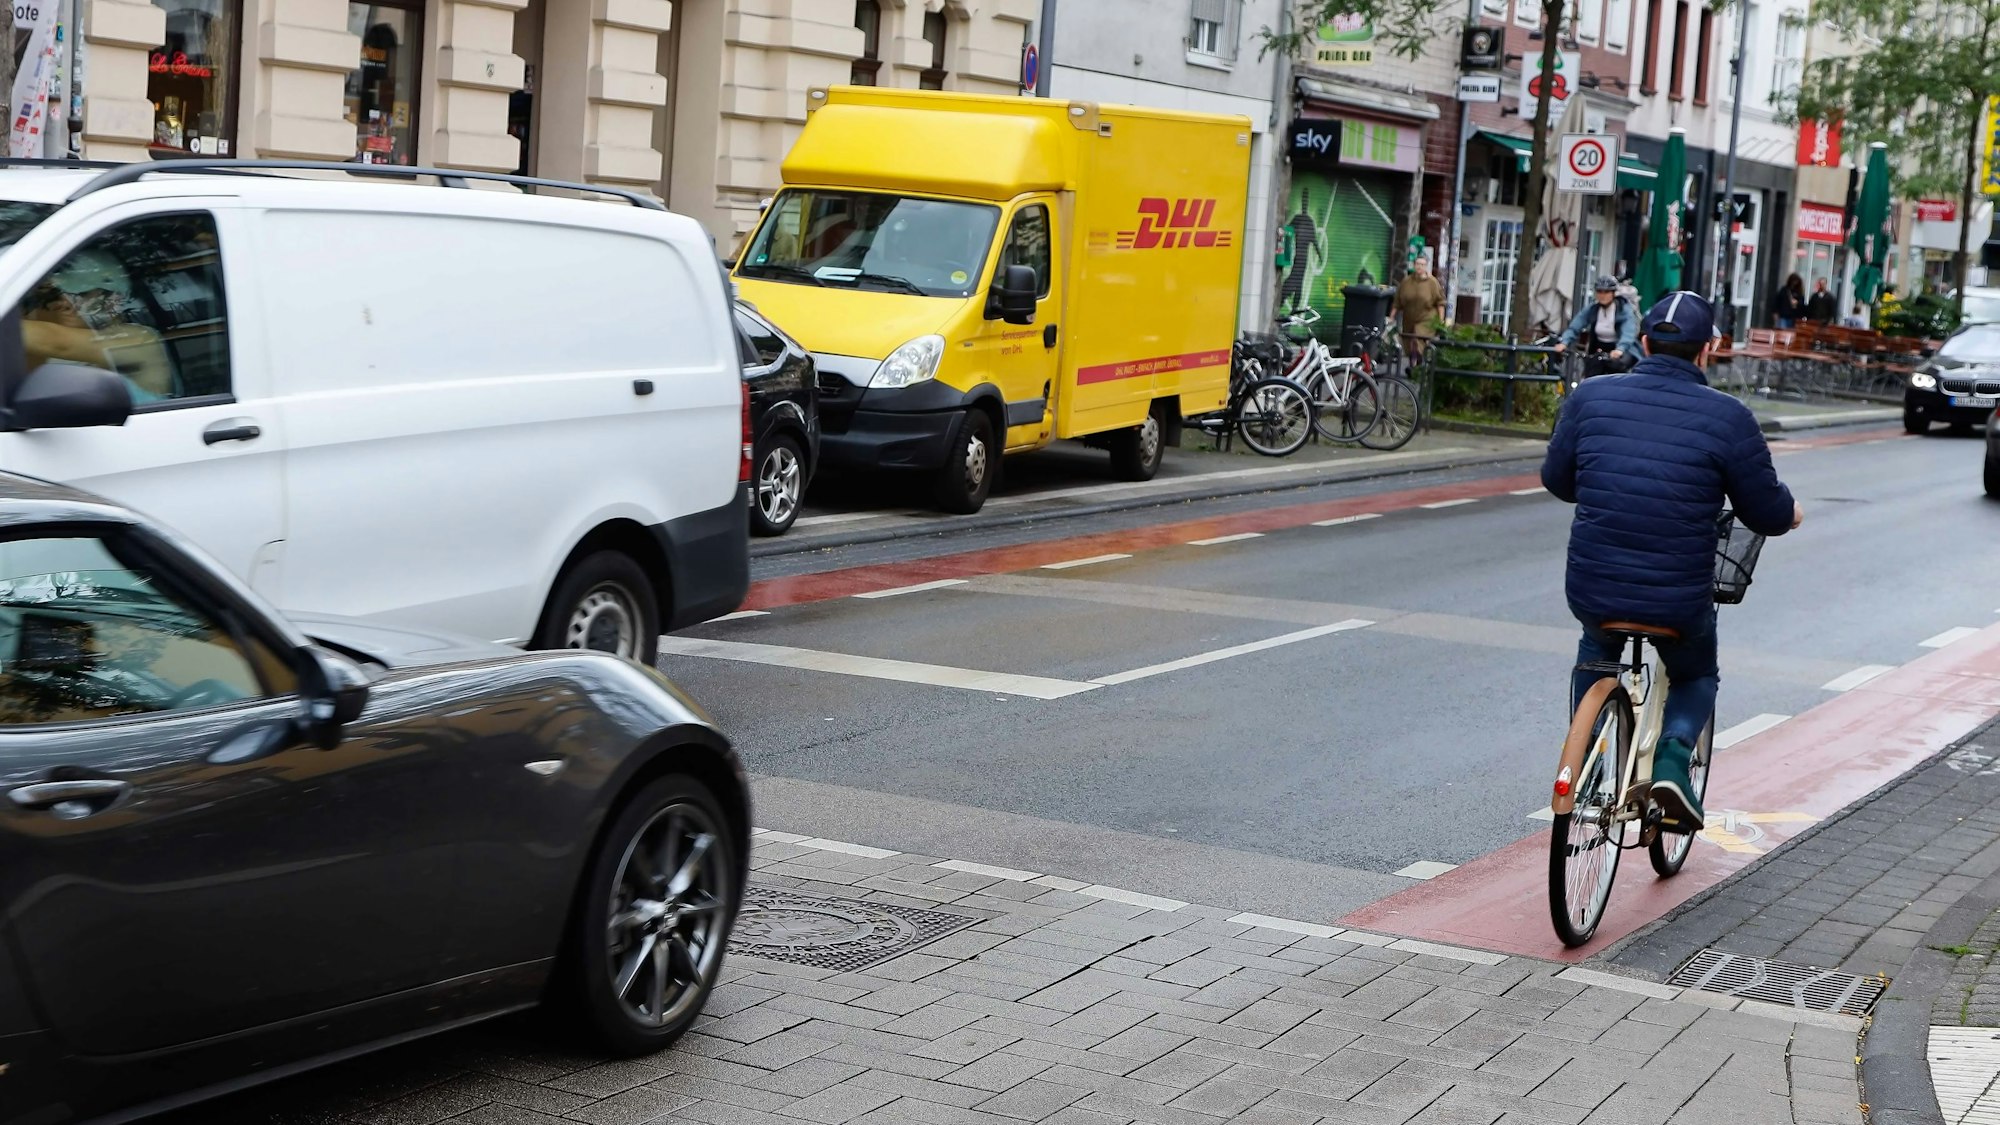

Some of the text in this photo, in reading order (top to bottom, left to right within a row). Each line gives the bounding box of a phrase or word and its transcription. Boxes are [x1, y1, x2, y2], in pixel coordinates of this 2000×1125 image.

[1295, 128, 1333, 153] sky
[1577, 149, 1598, 167] 20
[1571, 178, 1599, 189] ZONE
[1132, 197, 1219, 249] DHL
[1001, 343, 1022, 355] von DHL
